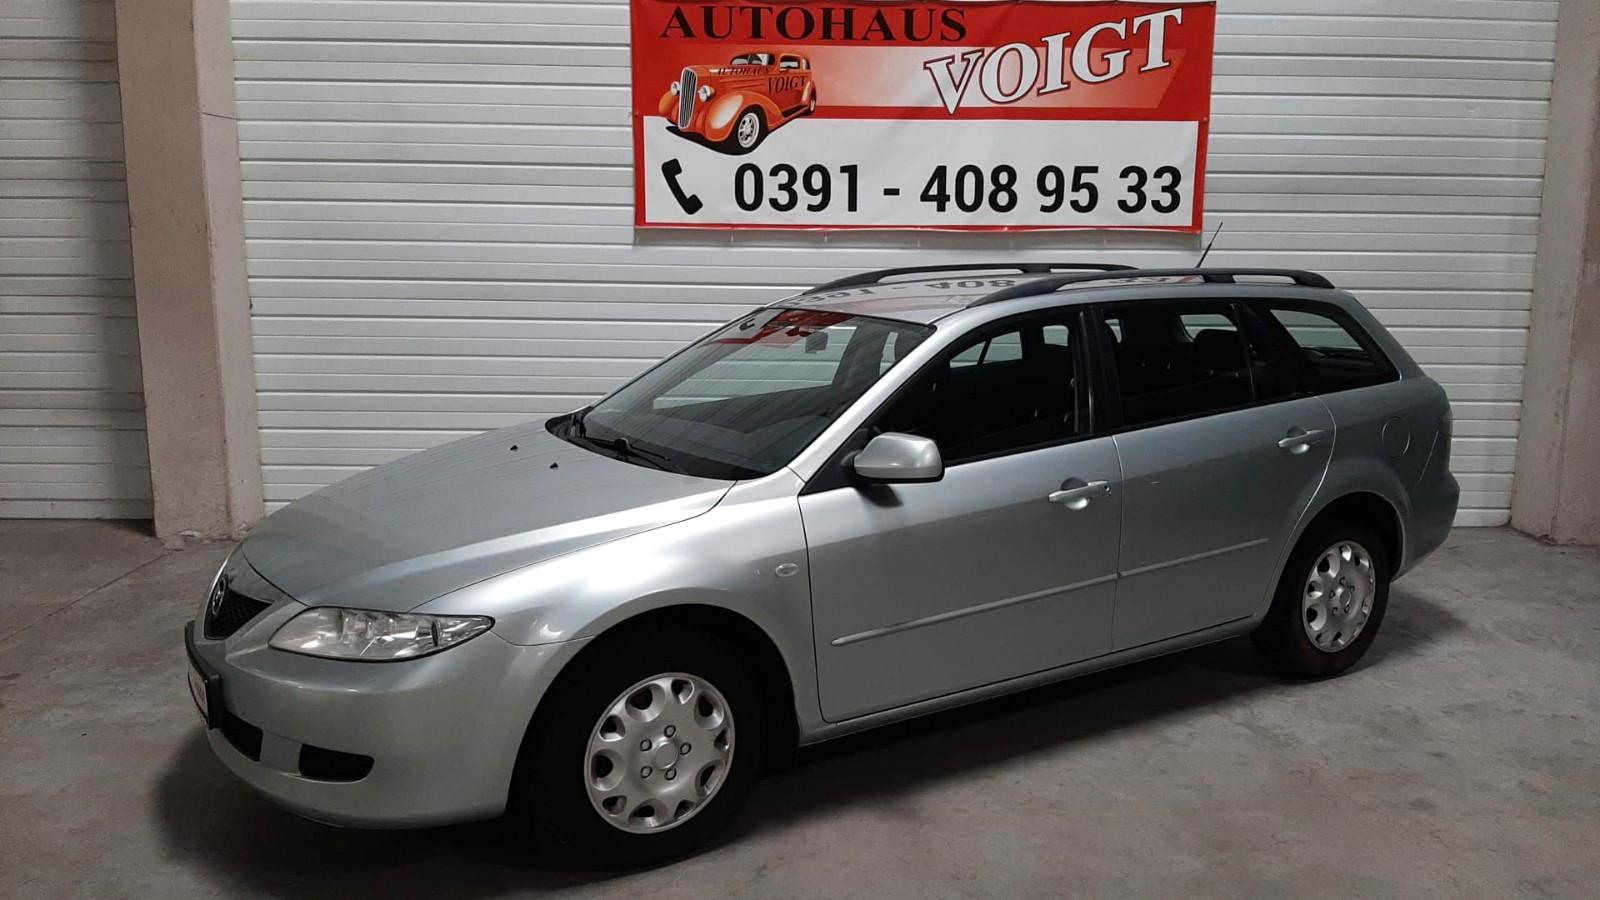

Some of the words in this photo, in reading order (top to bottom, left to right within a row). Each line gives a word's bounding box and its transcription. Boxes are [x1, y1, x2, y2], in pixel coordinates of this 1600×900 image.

[660, 6, 967, 42] AUTOHAUS
[924, 7, 1183, 115] VOIGT
[767, 75, 807, 95] VOIGT
[734, 163, 859, 213] 0391
[883, 186, 900, 197] -
[919, 163, 1018, 213] 408
[1035, 164, 1100, 214] 95
[1116, 164, 1183, 214] 33
